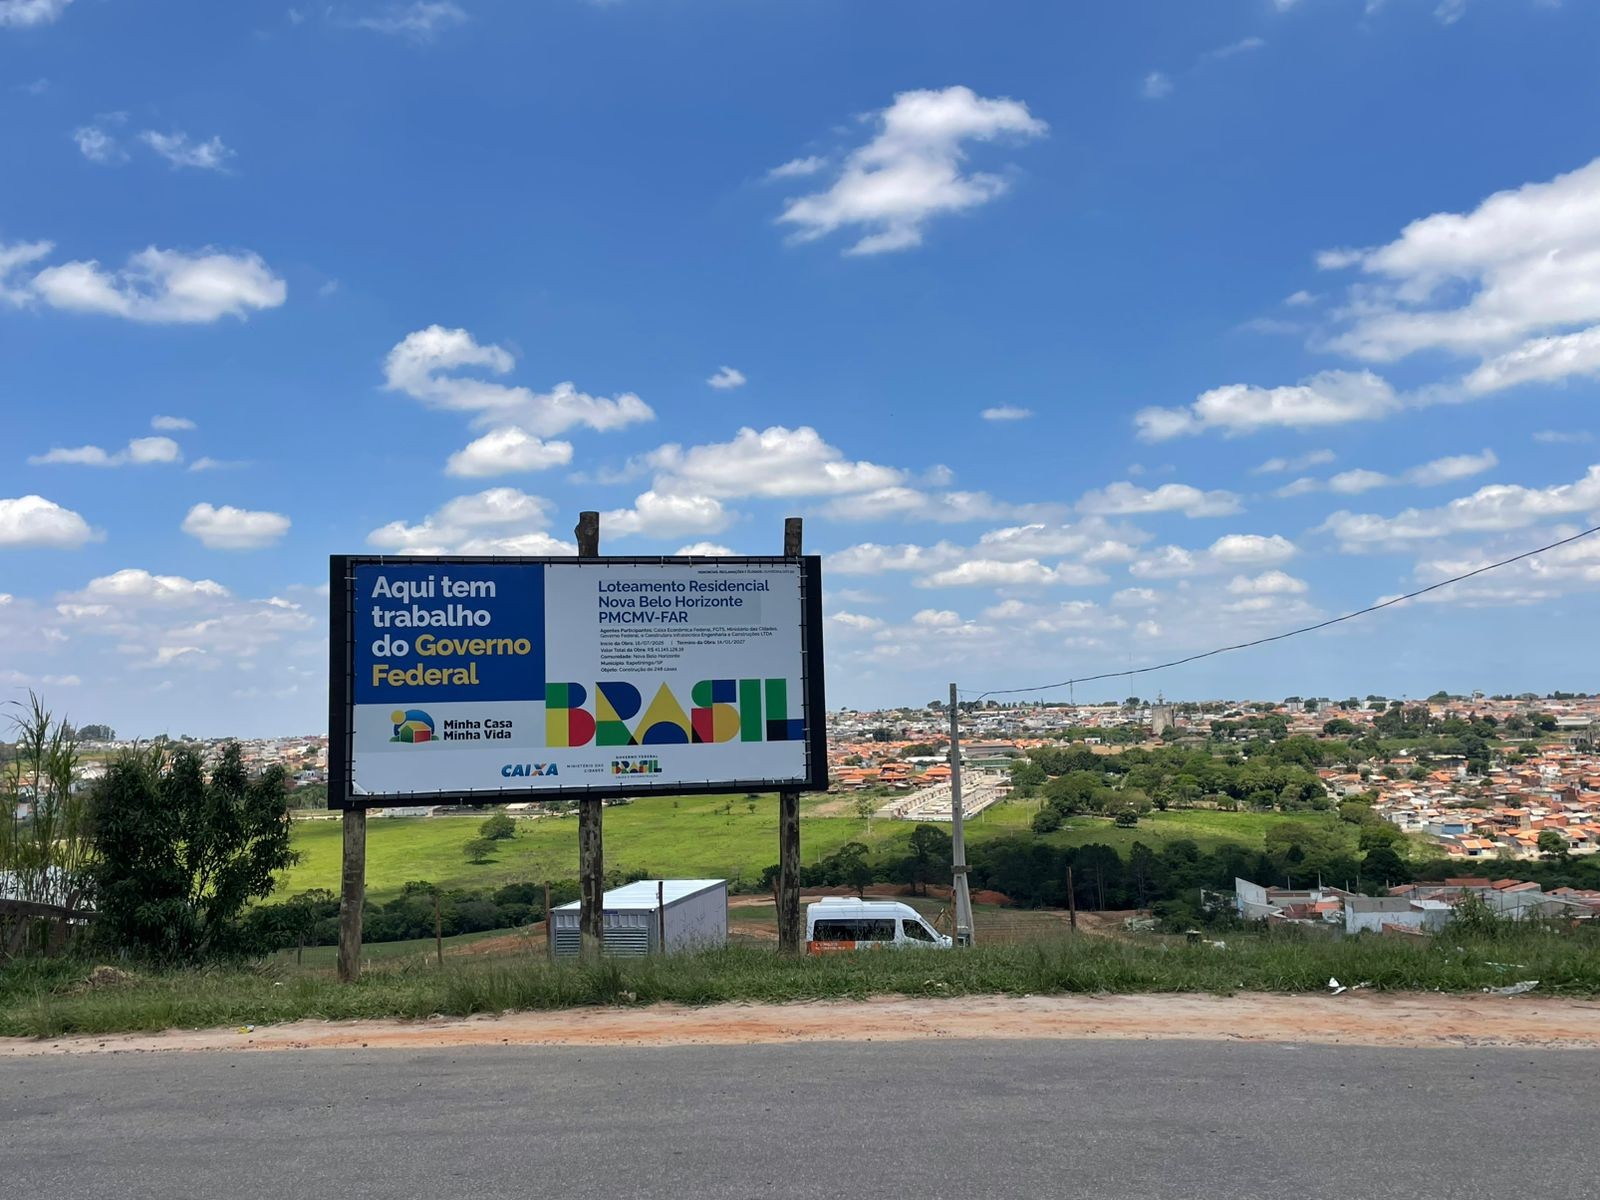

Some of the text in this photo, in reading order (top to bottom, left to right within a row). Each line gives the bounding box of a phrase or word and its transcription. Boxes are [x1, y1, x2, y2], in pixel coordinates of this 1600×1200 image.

[371, 575, 496, 604] Aqui tem
[598, 580, 770, 593] Loteamento Residencial
[599, 595, 743, 608] Nova Belo Horizonte
[371, 604, 491, 627] trabalho
[599, 611, 688, 624] PMCMV-FAR
[371, 634, 531, 657] do Governo
[372, 662, 480, 686] Federal
[545, 678, 805, 747] BRASIL
[443, 718, 513, 730] Minha Casa
[443, 730, 512, 740] Minha Vida
[501, 762, 558, 777] CAIXA
[612, 760, 662, 774] BRASIL
